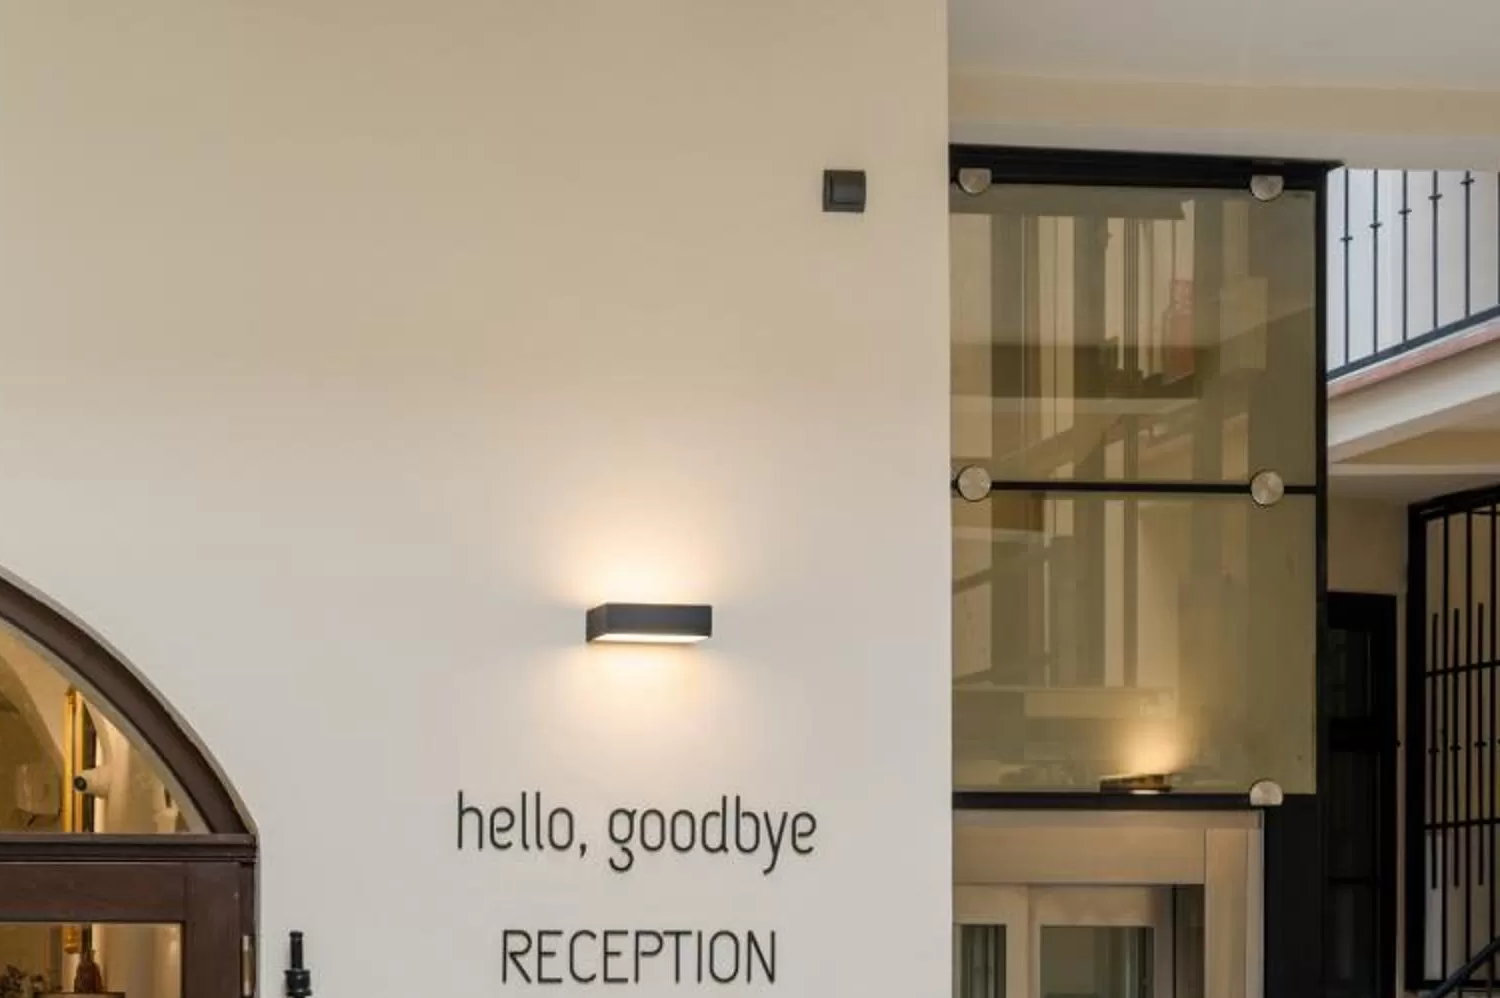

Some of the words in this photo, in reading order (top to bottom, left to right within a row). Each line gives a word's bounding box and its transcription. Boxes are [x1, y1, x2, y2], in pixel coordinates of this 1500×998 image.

[456, 789, 588, 859] hello,
[607, 794, 818, 876] goodbye
[500, 928, 777, 986] RECEPTION
